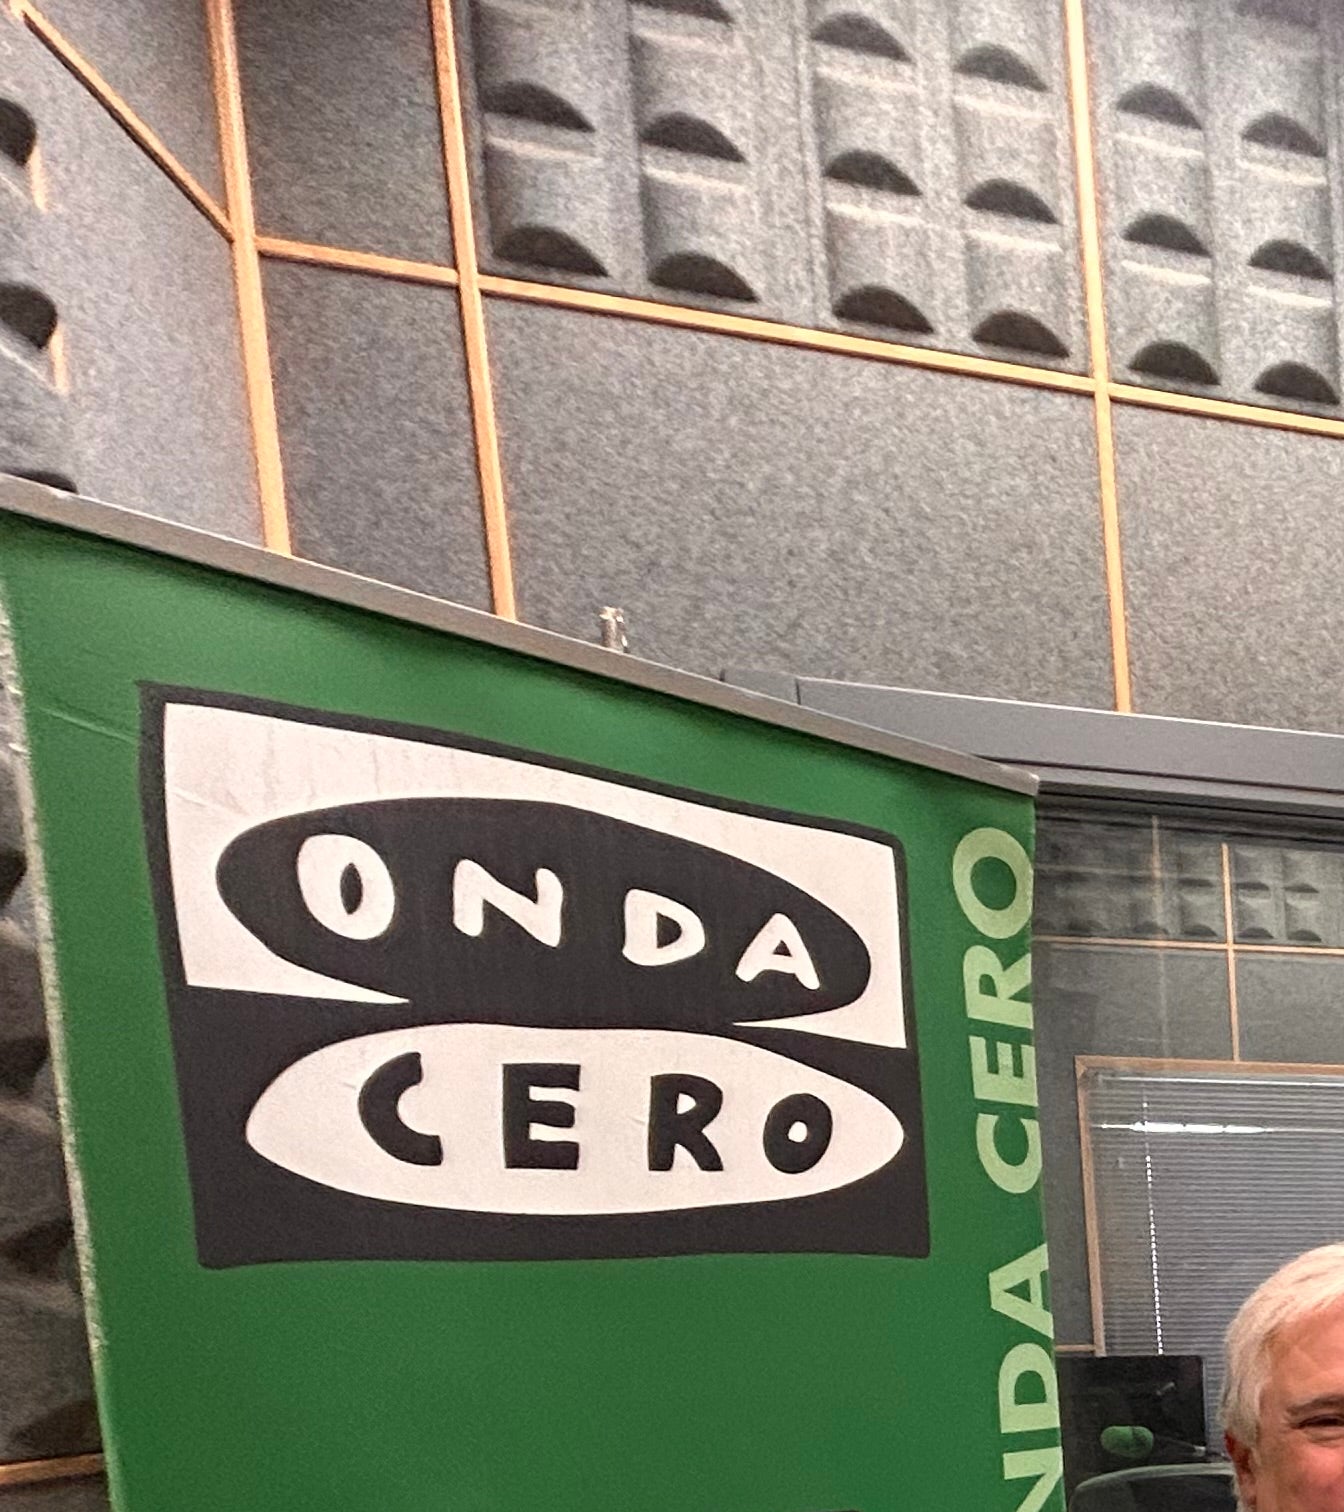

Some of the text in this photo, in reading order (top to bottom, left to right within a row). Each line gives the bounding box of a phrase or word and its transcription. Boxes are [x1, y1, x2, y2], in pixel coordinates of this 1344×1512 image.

[296, 833, 820, 990] ONDA
[952, 827, 1042, 1195] CERO
[358, 1051, 834, 1175] CERO
